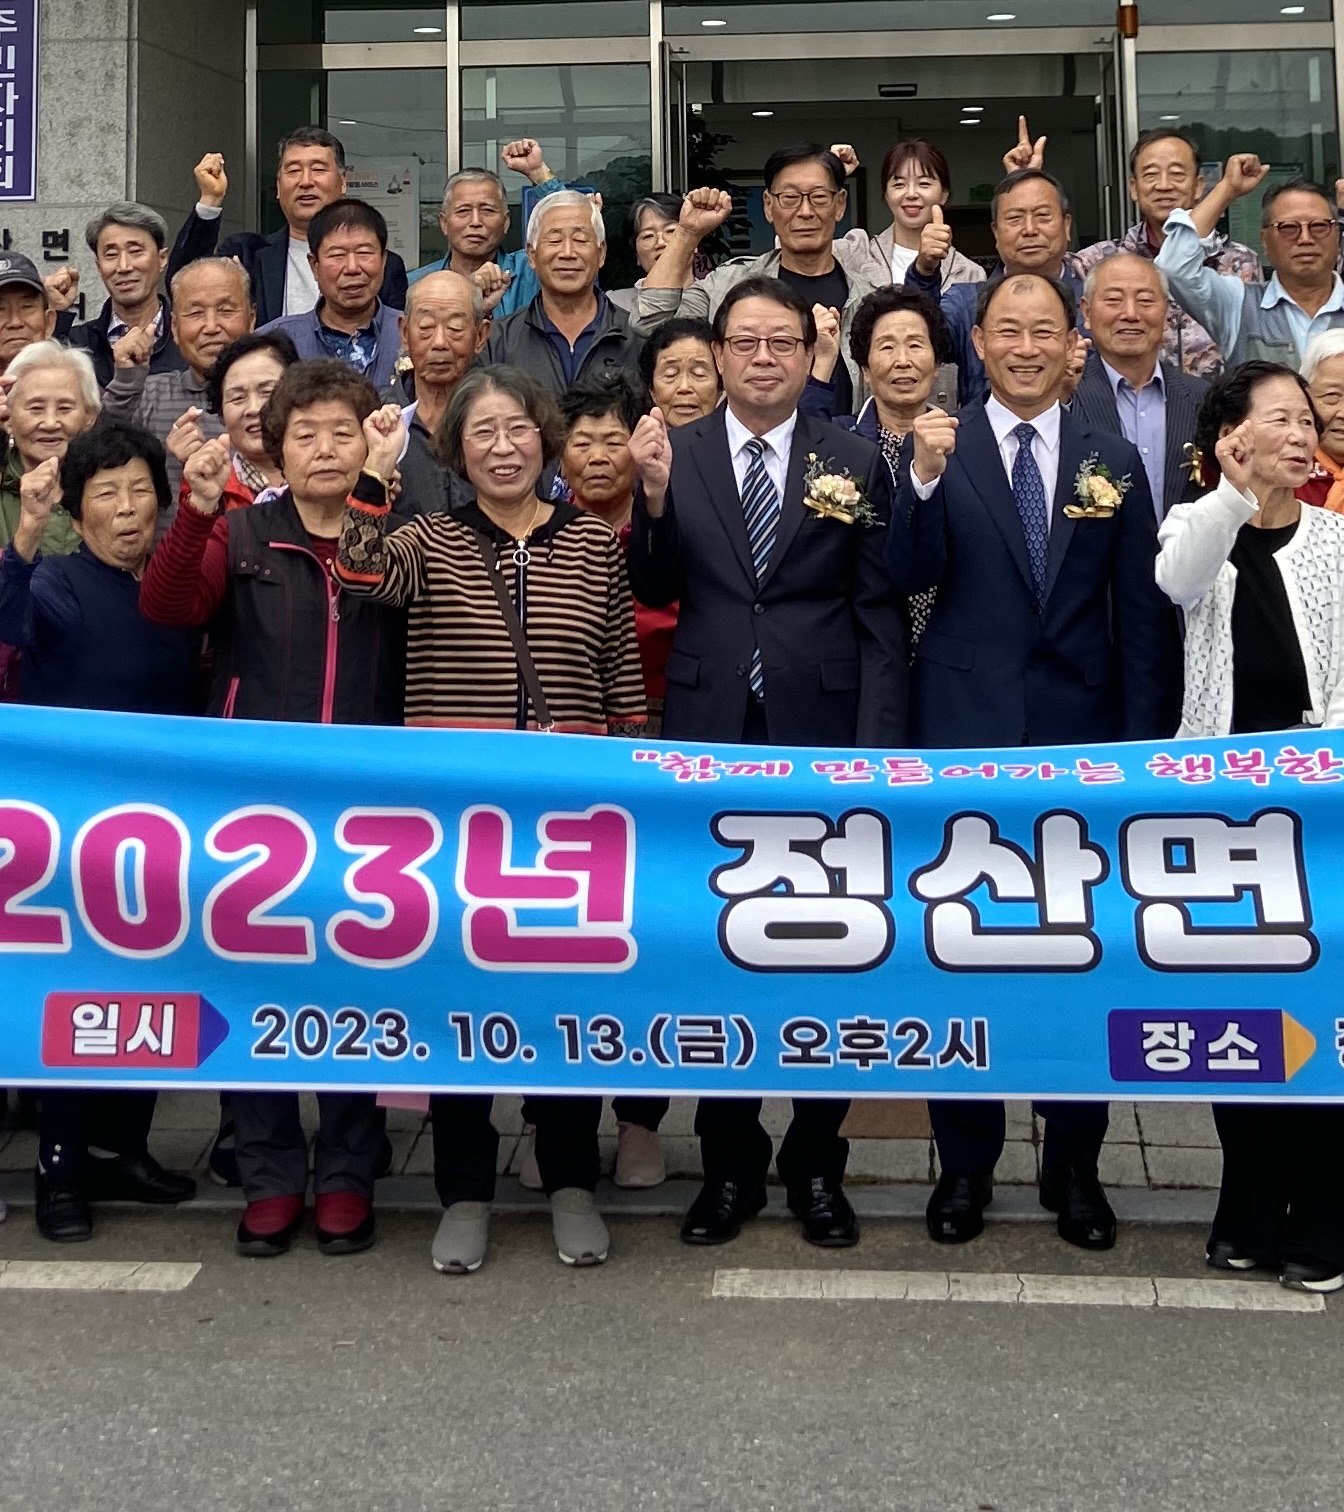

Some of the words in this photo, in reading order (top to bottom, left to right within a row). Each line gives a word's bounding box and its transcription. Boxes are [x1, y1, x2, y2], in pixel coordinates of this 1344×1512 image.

[1146, 744, 1344, 786] 행복한
[709, 807, 1321, 974] 정산면
[70, 1002, 176, 1058] 일시
[251, 1004, 431, 1061] 2023.
[449, 1011, 536, 1063] 10.
[778, 1017, 990, 1071] 오후2시
[1140, 1019, 1262, 1074] 장소
